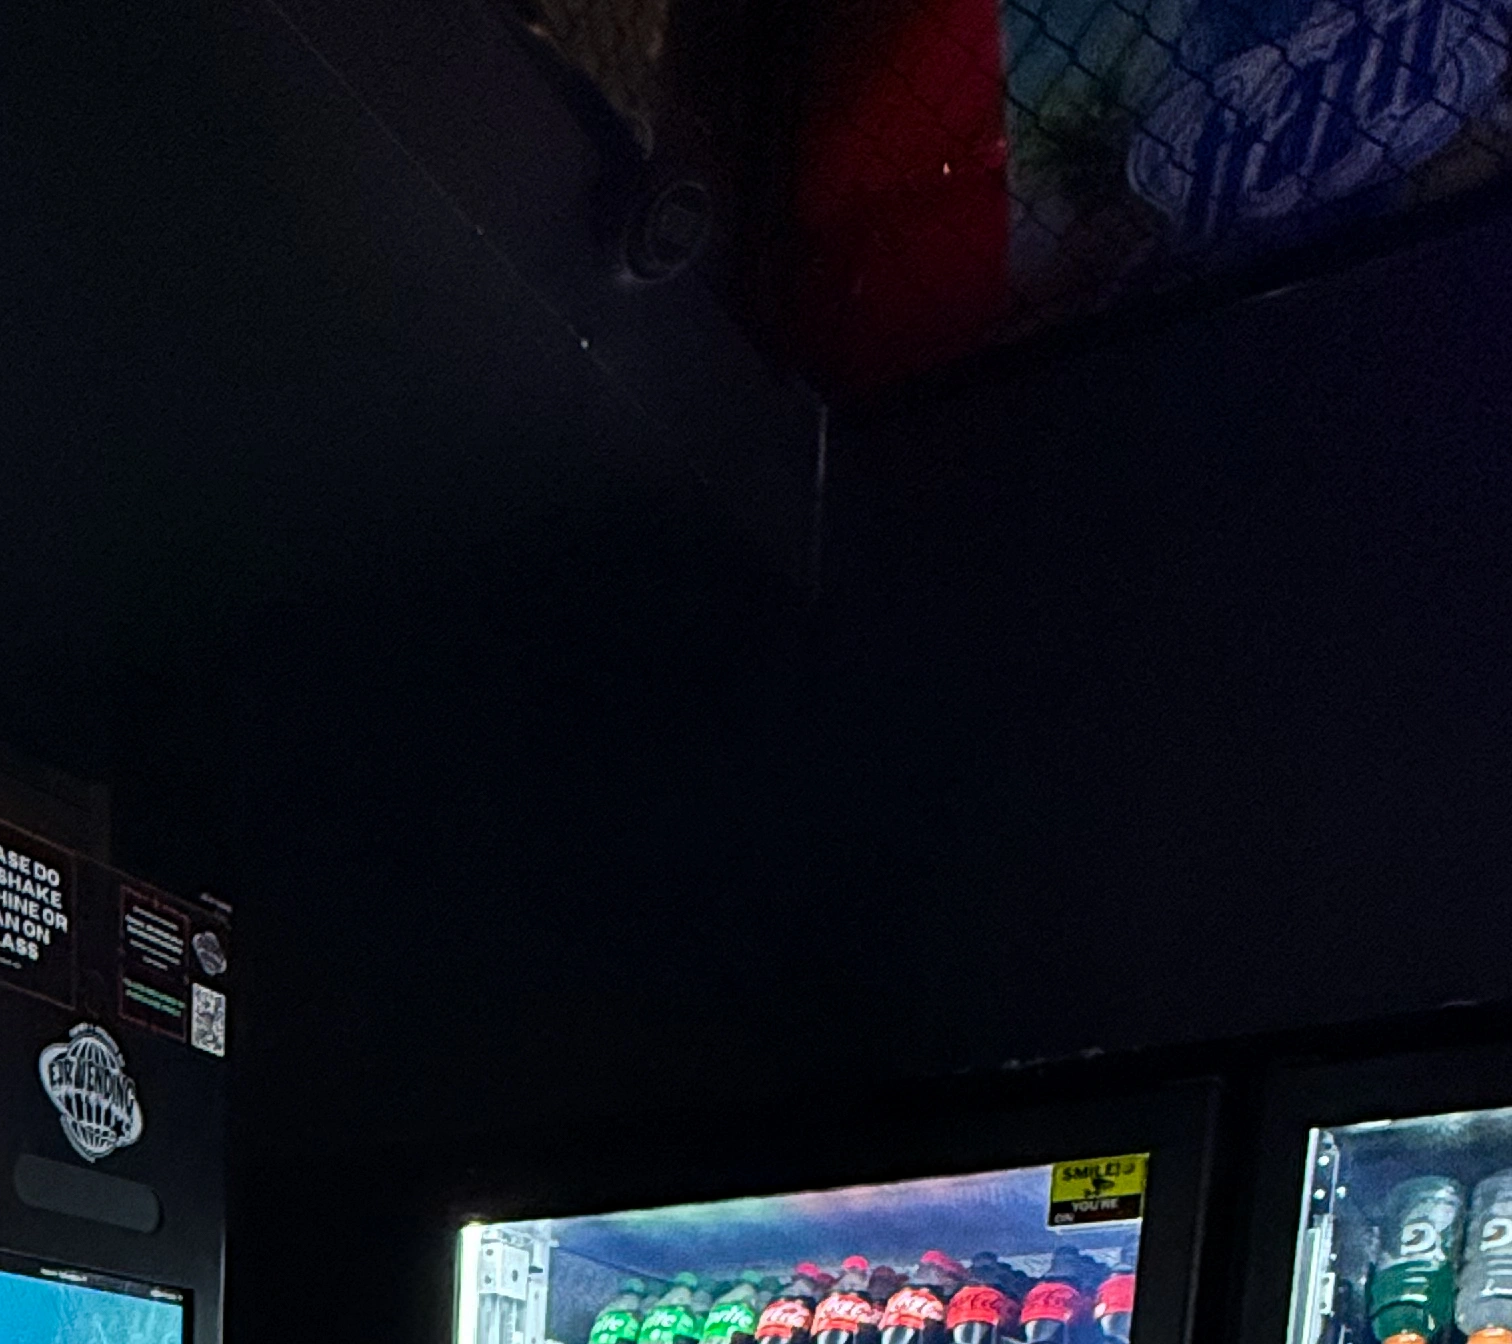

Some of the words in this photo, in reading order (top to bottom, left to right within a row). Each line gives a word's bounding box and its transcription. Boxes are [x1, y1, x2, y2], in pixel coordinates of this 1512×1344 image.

[33, 860, 61, 888] DO
[23, 918, 52, 947] ON
[41, 906, 69, 934] OR
[1061, 1160, 1123, 1183] SMILE!
